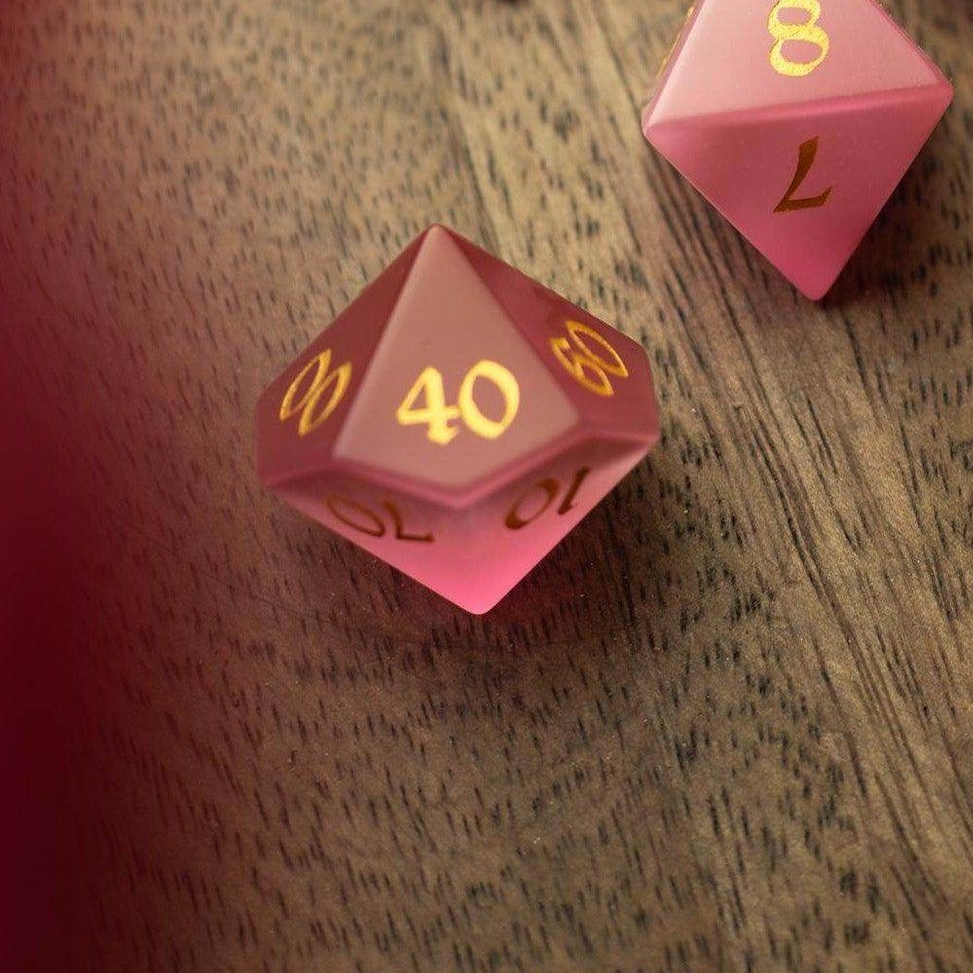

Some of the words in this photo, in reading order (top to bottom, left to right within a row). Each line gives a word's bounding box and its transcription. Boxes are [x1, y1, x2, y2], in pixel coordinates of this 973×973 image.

[773, 136, 834, 213] 7
[396, 359, 521, 445] 40
[326, 494, 436, 543] 70
[504, 466, 590, 531] 10
